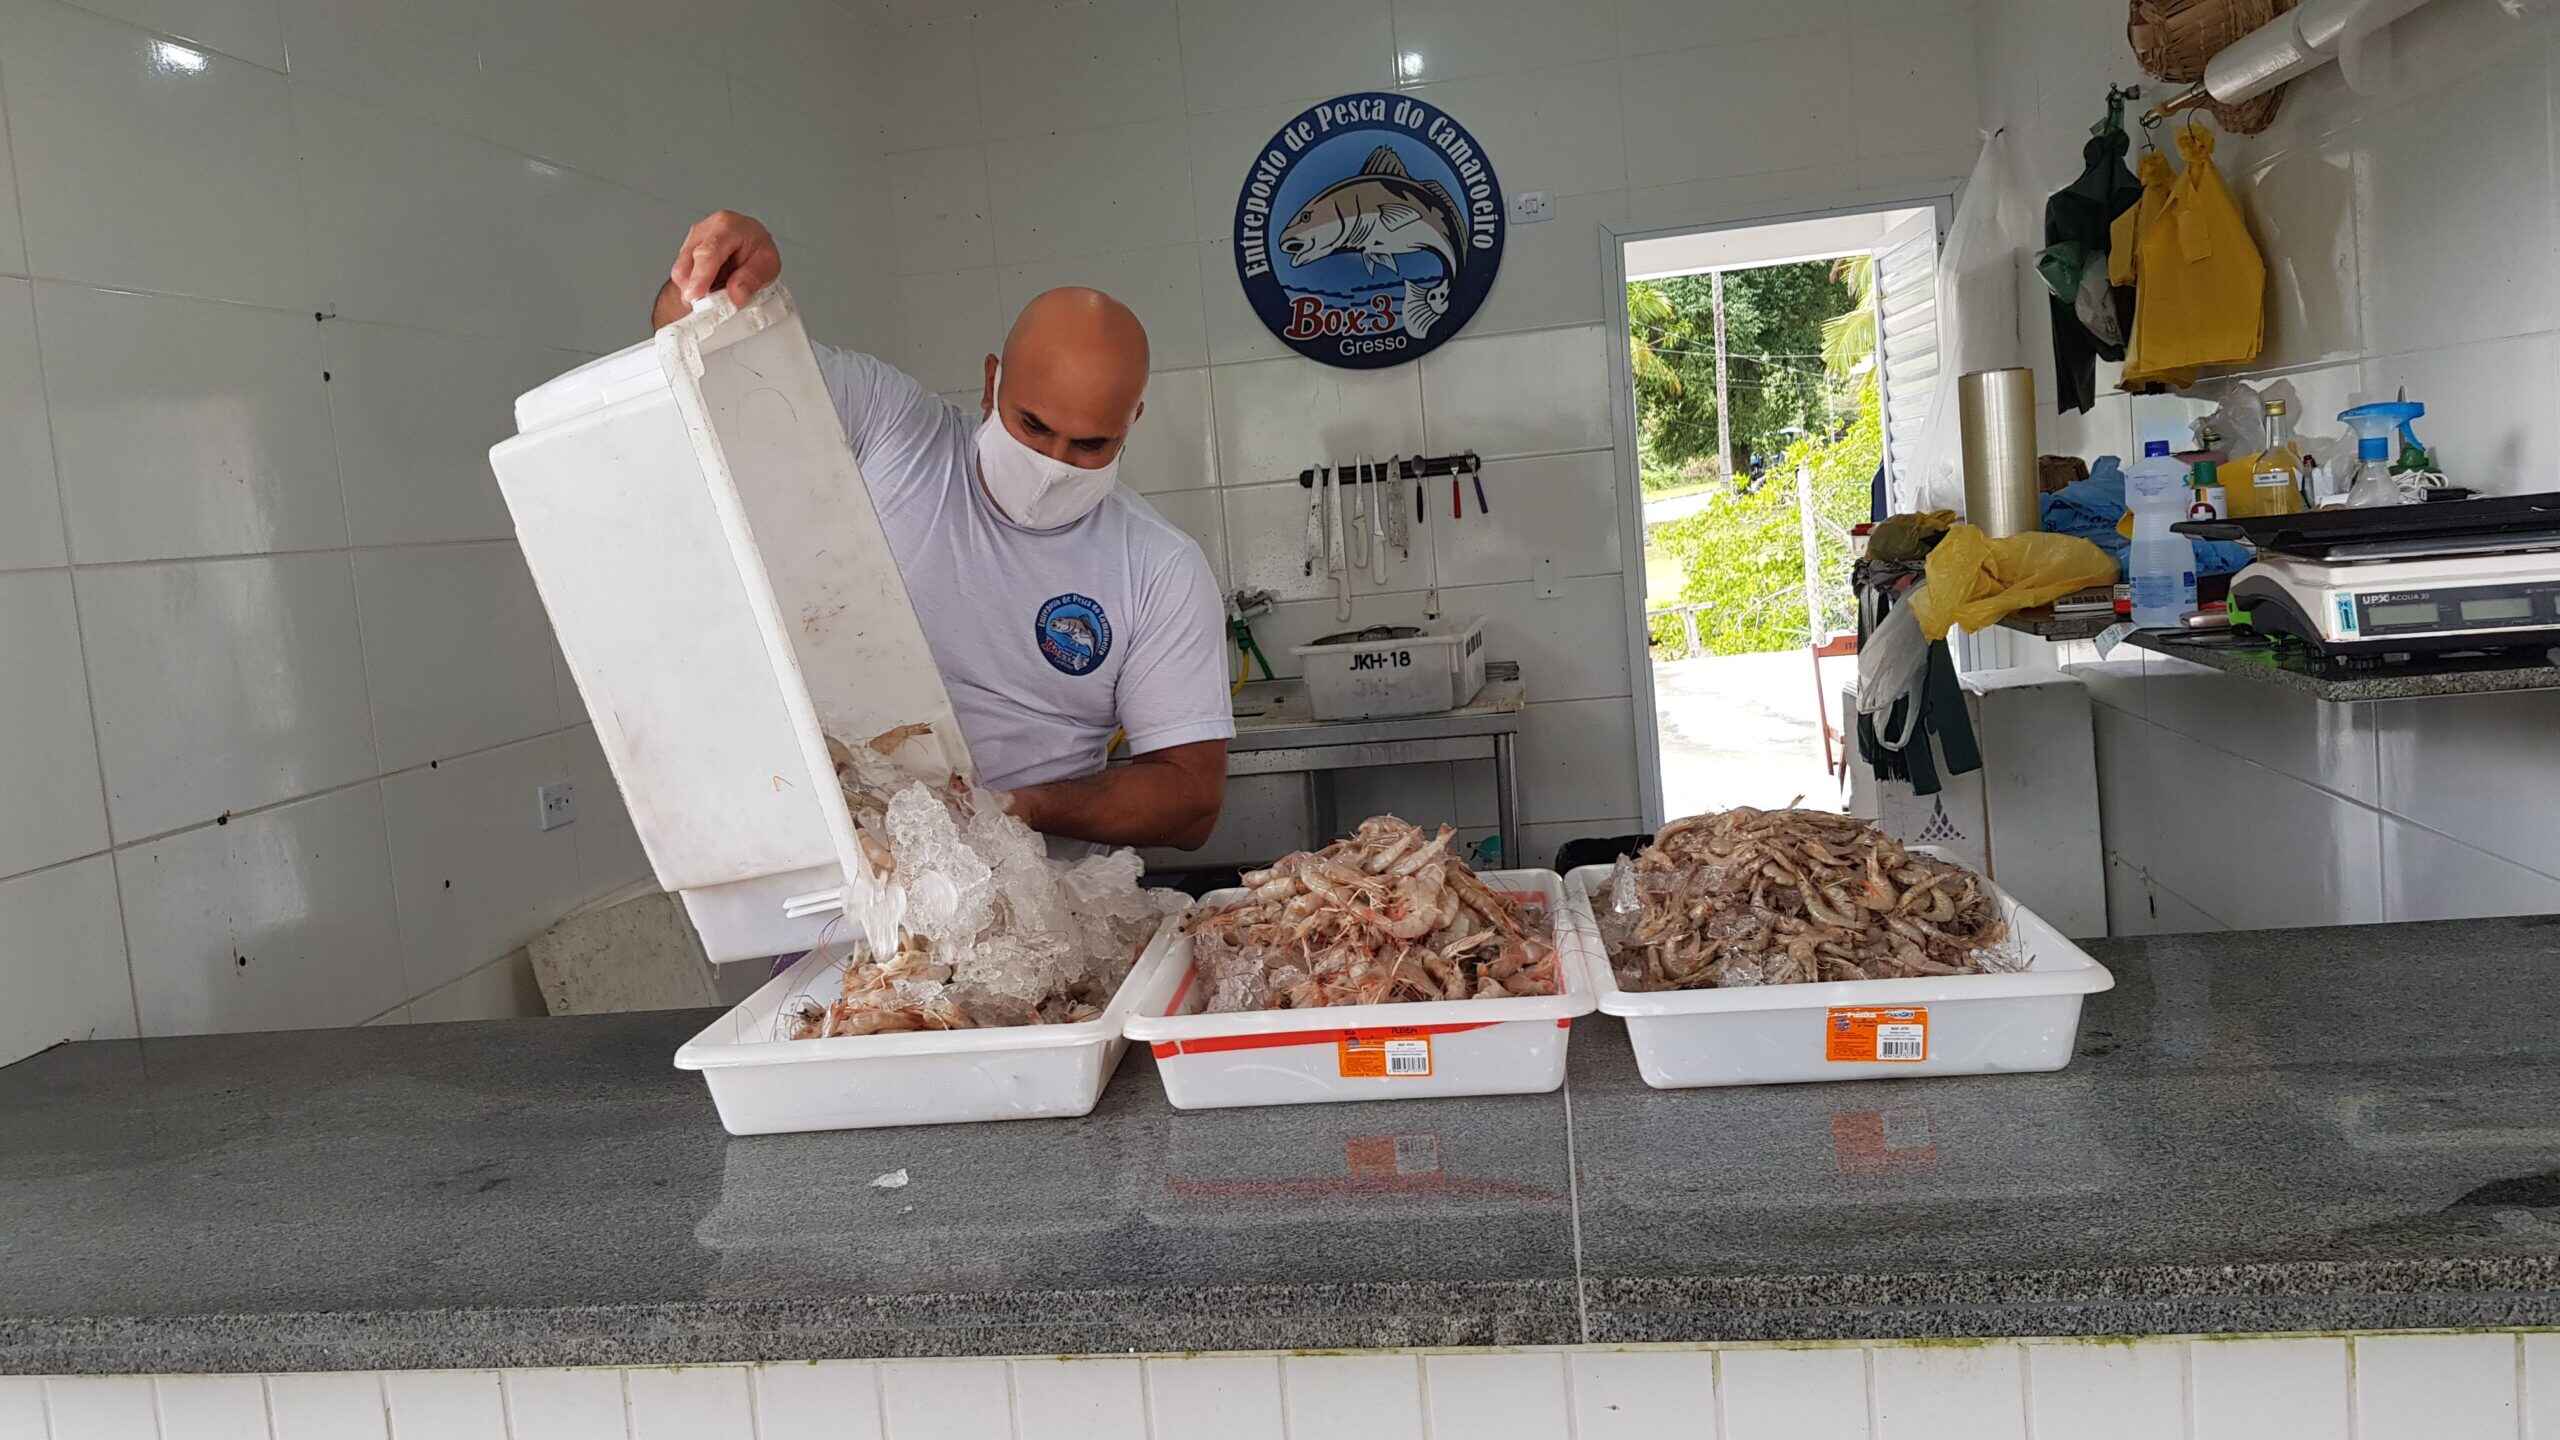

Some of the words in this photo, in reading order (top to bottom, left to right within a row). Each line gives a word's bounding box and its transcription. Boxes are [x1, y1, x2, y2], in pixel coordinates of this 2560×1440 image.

[1243, 150, 1287, 278] Entreposto
[1284, 122, 1315, 152] de
[1316, 98, 1387, 132] Pesca
[1393, 100, 1425, 129] do
[1427, 116, 1496, 249] Camaroeiro
[1284, 296, 1368, 341] Box
[1370, 295, 1397, 334] 3
[1339, 336, 1407, 356] Gresso
[1349, 651, 1411, 671] JKH-18
